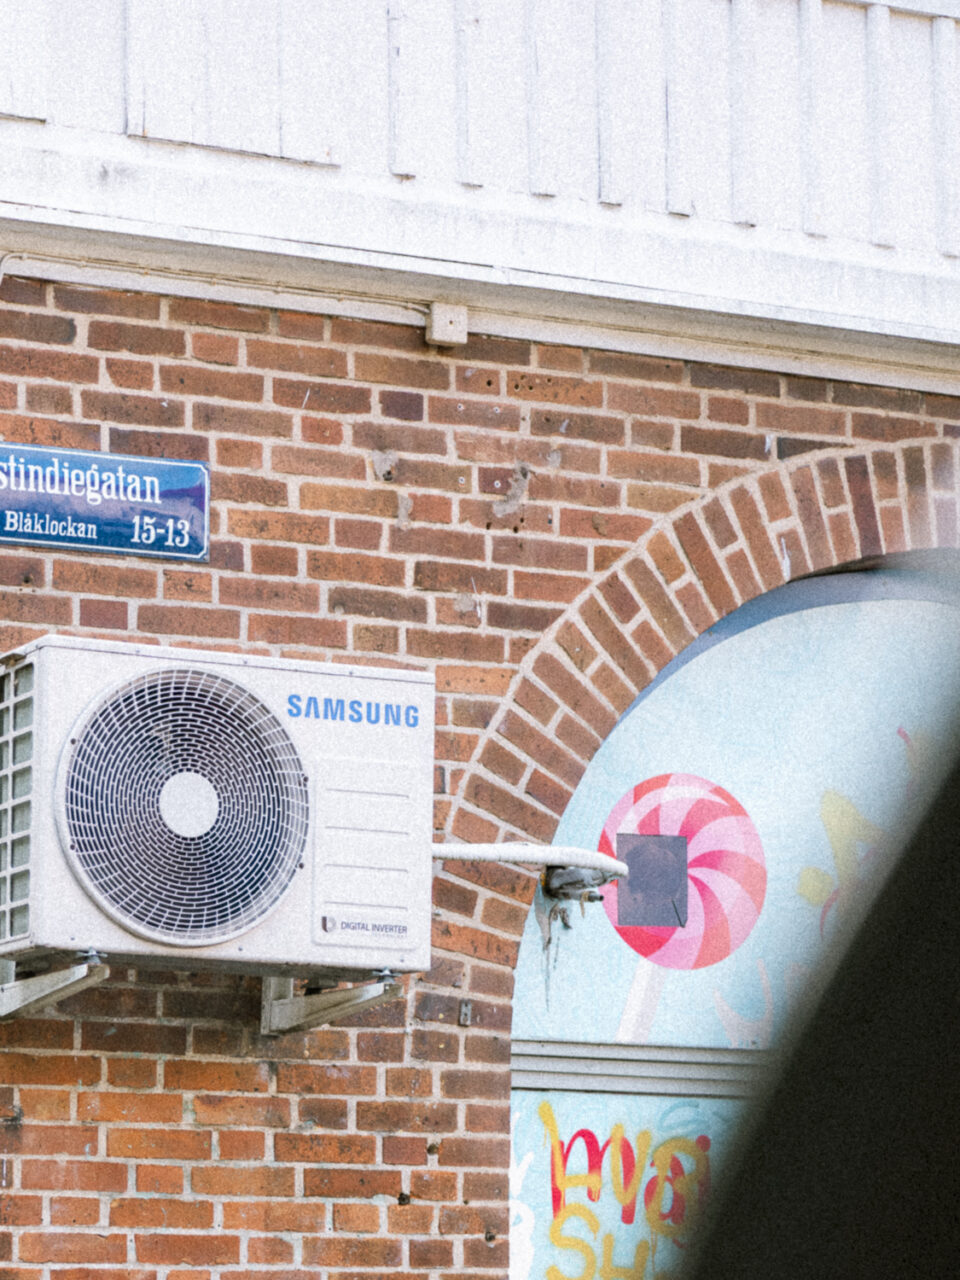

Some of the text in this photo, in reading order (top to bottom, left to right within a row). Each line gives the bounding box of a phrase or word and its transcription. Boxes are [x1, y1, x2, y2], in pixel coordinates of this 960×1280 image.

[3, 510, 98, 541] Blåklockan
[130, 514, 192, 548] 15-13
[287, 693, 420, 729] SAMSUNG
[341, 921, 408, 935] DIGITAL INVERTER
